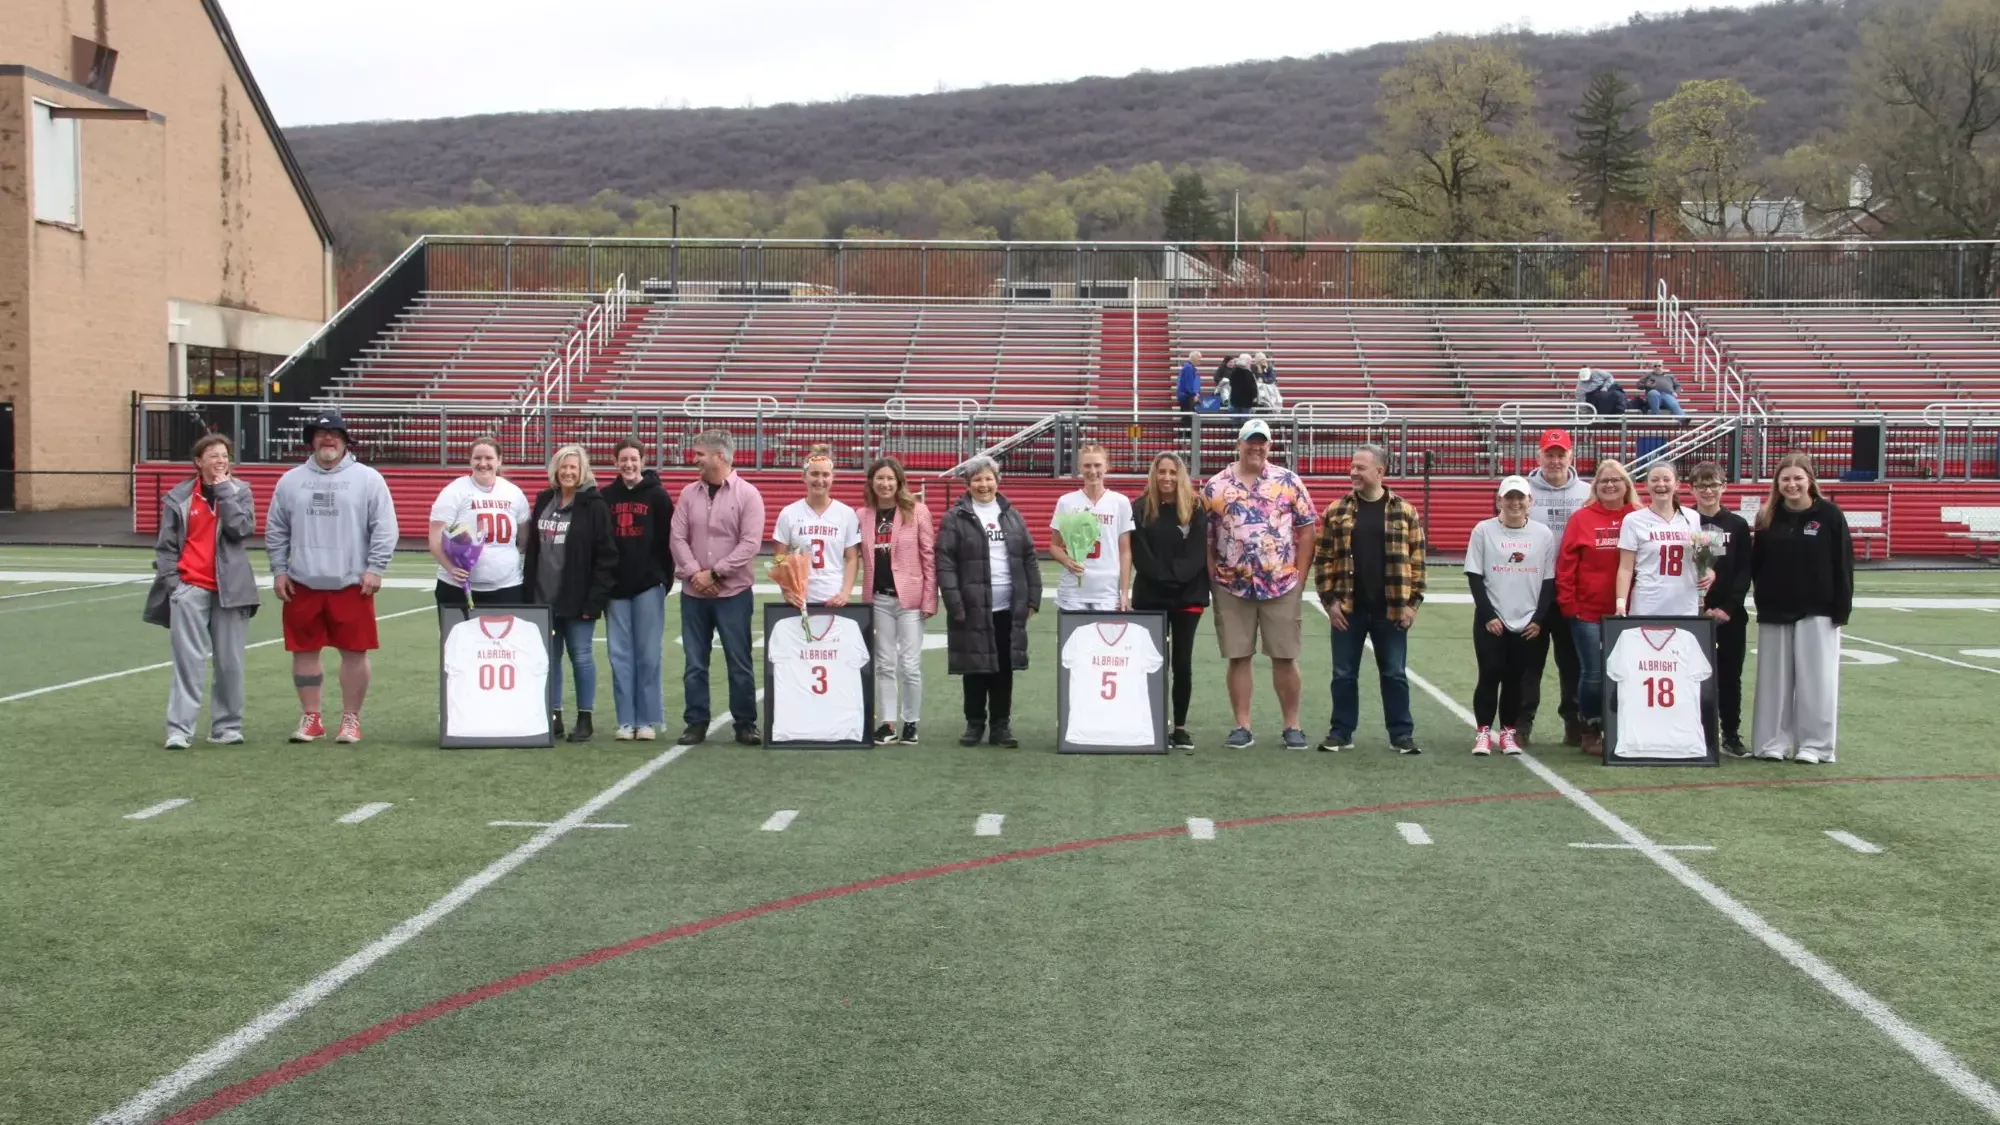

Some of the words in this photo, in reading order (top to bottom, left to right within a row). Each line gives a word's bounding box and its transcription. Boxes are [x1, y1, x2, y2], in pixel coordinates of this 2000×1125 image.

[471, 499, 512, 510] ALBRIGHT
[798, 525, 839, 537] ALBRIGHT
[811, 538, 825, 569] 3
[1659, 544, 1684, 577] 18
[477, 649, 517, 660] ALBRIGHT
[799, 649, 839, 660] ALBRIGHT
[1091, 655, 1130, 667] ALBRIGHT
[1638, 660, 1678, 672] ALBRIGHT
[479, 664, 516, 691] 00
[811, 665, 829, 695] 3
[1100, 671, 1118, 700] 5
[1643, 677, 1676, 708] 18
